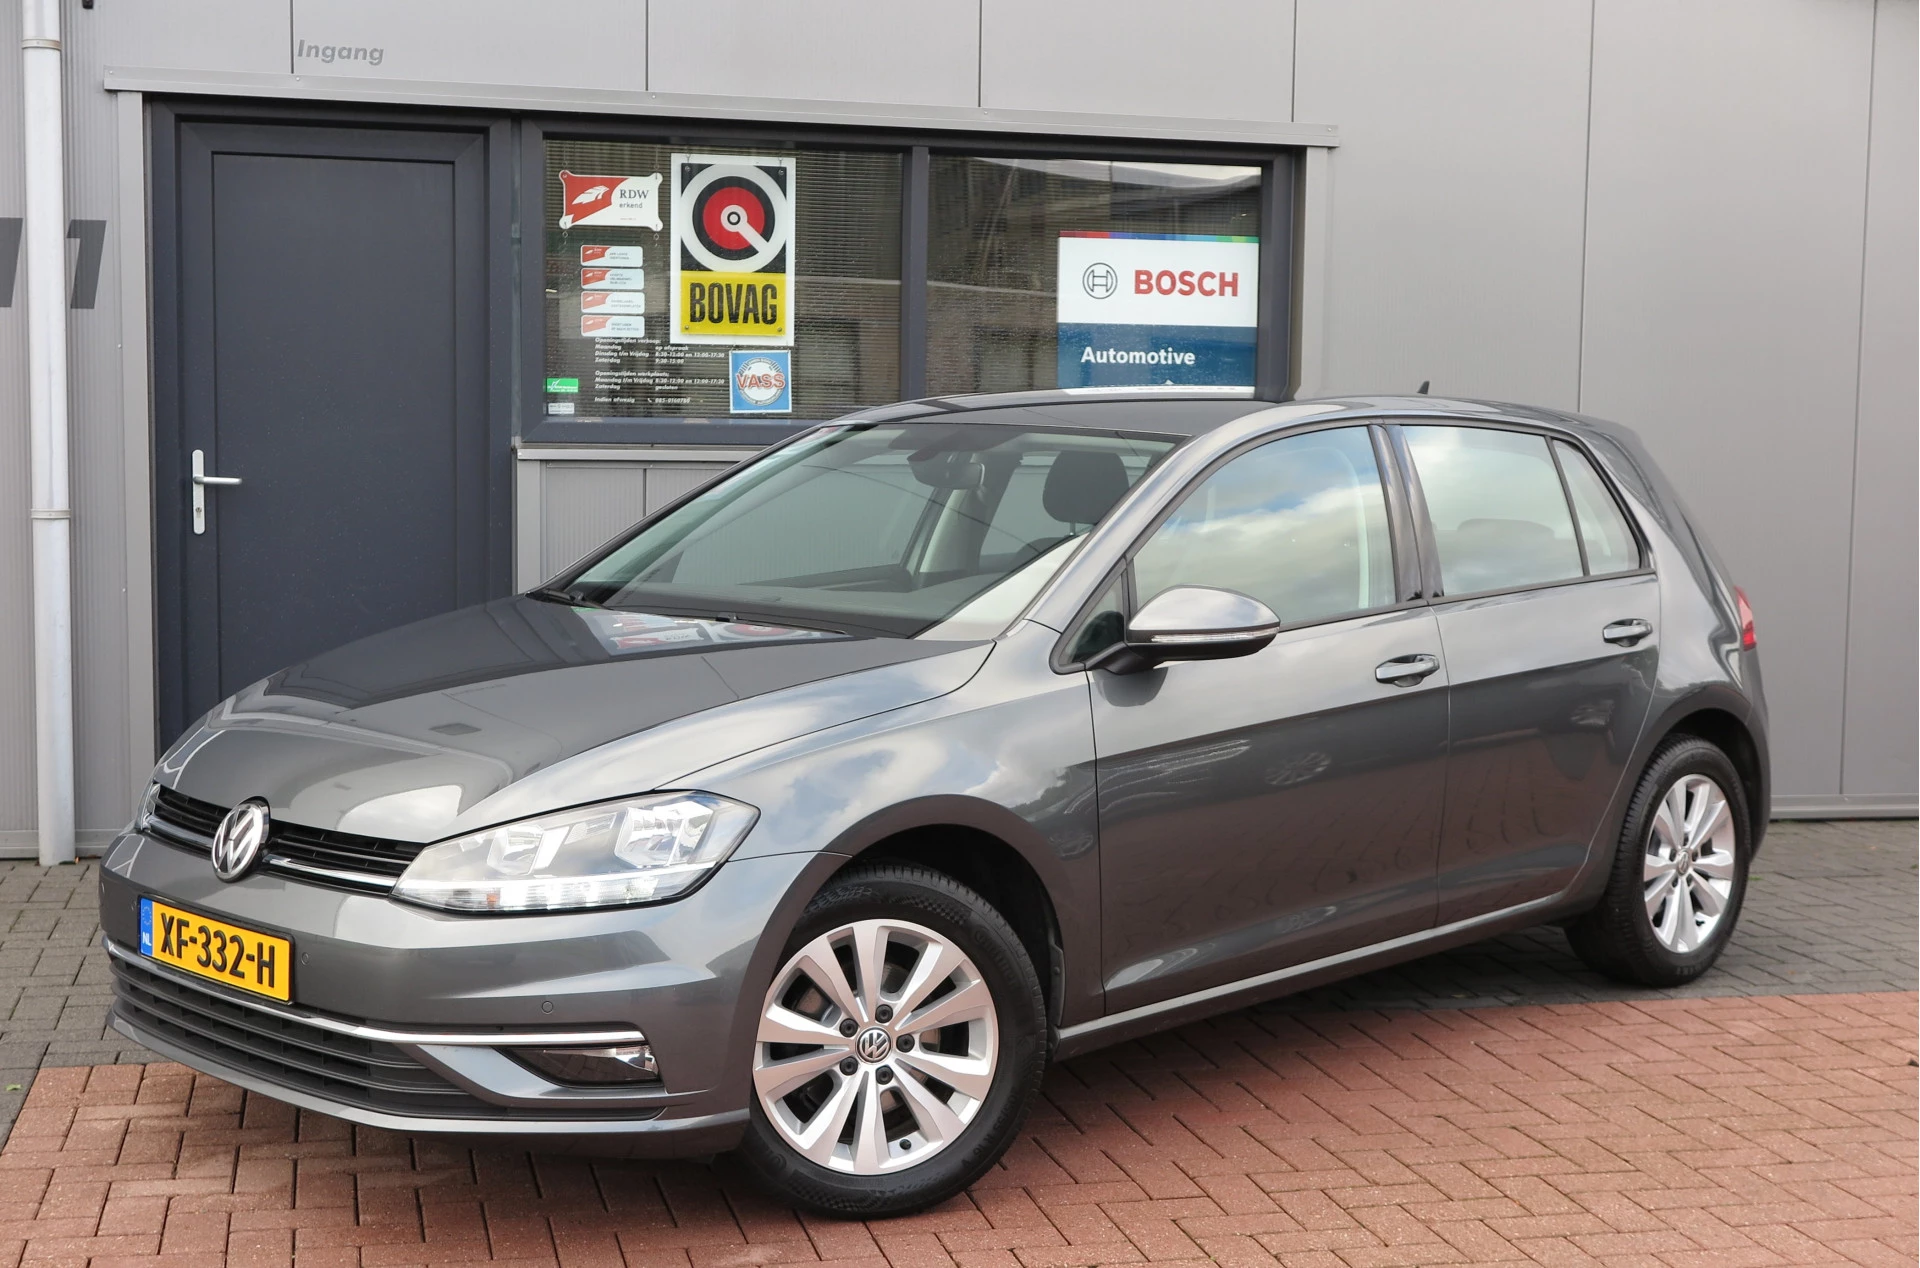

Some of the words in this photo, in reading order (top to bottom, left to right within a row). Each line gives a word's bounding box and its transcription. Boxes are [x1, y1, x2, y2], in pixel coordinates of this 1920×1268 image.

[297, 39, 384, 66] Ingang
[620, 189, 649, 199] RDW
[1134, 270, 1238, 297] BOSCH
[689, 282, 778, 325] BOVAG
[1081, 346, 1196, 365] Automotive
[736, 373, 785, 389] VASS
[142, 931, 152, 946] NL
[160, 912, 276, 988] XF-332-H
